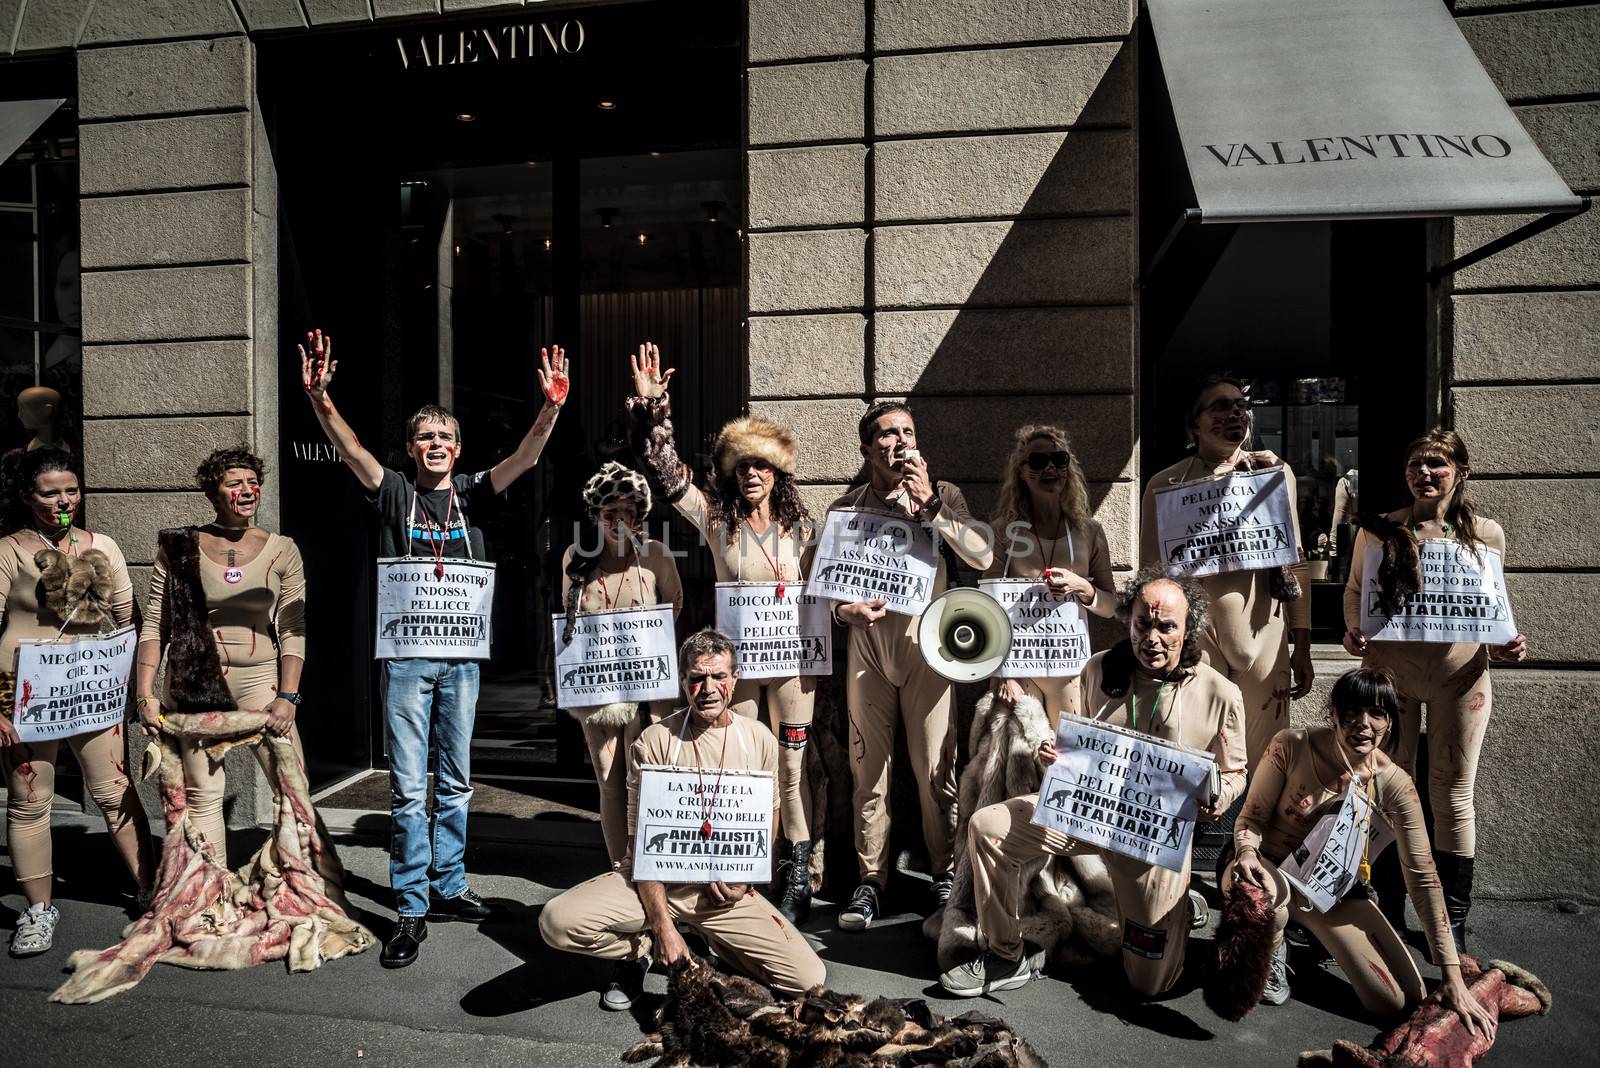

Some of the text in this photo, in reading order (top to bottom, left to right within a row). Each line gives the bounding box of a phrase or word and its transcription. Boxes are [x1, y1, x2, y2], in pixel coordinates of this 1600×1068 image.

[396, 19, 585, 69] VALENTINO
[1201, 134, 1512, 167] VALENTINO
[293, 441, 342, 463] VALENT
[1181, 485, 1257, 506] PELLICCIA
[1199, 502, 1243, 517] MODA
[1185, 516, 1261, 535] ASSASSINA
[1186, 529, 1271, 549] ANIMALISTI
[1189, 540, 1270, 560] ITALIANI
[1419, 551, 1452, 561] ORTE
[839, 550, 909, 571] ASSASSINA
[1180, 551, 1277, 571] WWW.ANIMALISTI.IT
[387, 572, 488, 586] SOLO U MOSTRO
[835, 563, 914, 585] ANIMALISTI
[415, 586, 468, 597] INDOSSA
[834, 573, 908, 596] ITALIANI
[411, 600, 471, 611] PELLICCE
[795, 595, 817, 606] CHI
[1409, 594, 1491, 606] IMALISTI
[754, 610, 794, 622] VENDE
[1019, 607, 1062, 618] MODA
[1404, 605, 1487, 618] TALIANI
[400, 614, 478, 626] ANIMALISTI
[571, 618, 663, 635] OLO UN MOSTRO
[402, 626, 475, 638] ITALIANI
[744, 625, 802, 638] PELLICCE
[1012, 623, 1075, 634] SSASSINA
[1381, 622, 1494, 633] WWW.ANIMALISTI.IT
[394, 639, 479, 648] WWW.ANIMALISTI.IT
[588, 634, 637, 647] INDOSSA
[740, 639, 812, 651] ANIMALISTI
[1012, 637, 1079, 648] NIMALISTI
[39, 642, 127, 666] MEGLIO NUDI
[585, 646, 642, 660] PELLICCE
[742, 650, 808, 663] ITALIANI
[1010, 648, 1077, 659] TALIANI
[66, 663, 111, 680] CHE IN
[577, 659, 655, 675] ANIMALISTI
[740, 661, 814, 673] WW.ANIMALISTI.IT
[580, 670, 652, 686] ITALIANI
[49, 676, 120, 697] PELLICCIA
[573, 681, 661, 695] WWW.ANIMALISTI.IT
[47, 686, 125, 710] ANIMALISTI
[49, 697, 122, 722] ITALIANI
[1076, 734, 1186, 776] MEGLIO NUDI
[1098, 760, 1153, 787] CHE IN
[668, 782, 753, 795] LA MORTE E LA
[1077, 773, 1163, 810] PELLICCIA
[679, 796, 744, 808] CRUDELTA'
[1072, 788, 1168, 828] ANIMALISTI
[646, 808, 766, 822] NON RENDONO BELLE
[1071, 801, 1161, 840] ITALIANI
[1055, 813, 1163, 856] WWW.ANIMALISTI.IT
[670, 842, 751, 856] ITALIANI
[655, 861, 754, 872] WWW.ANIMALISTI.IT
